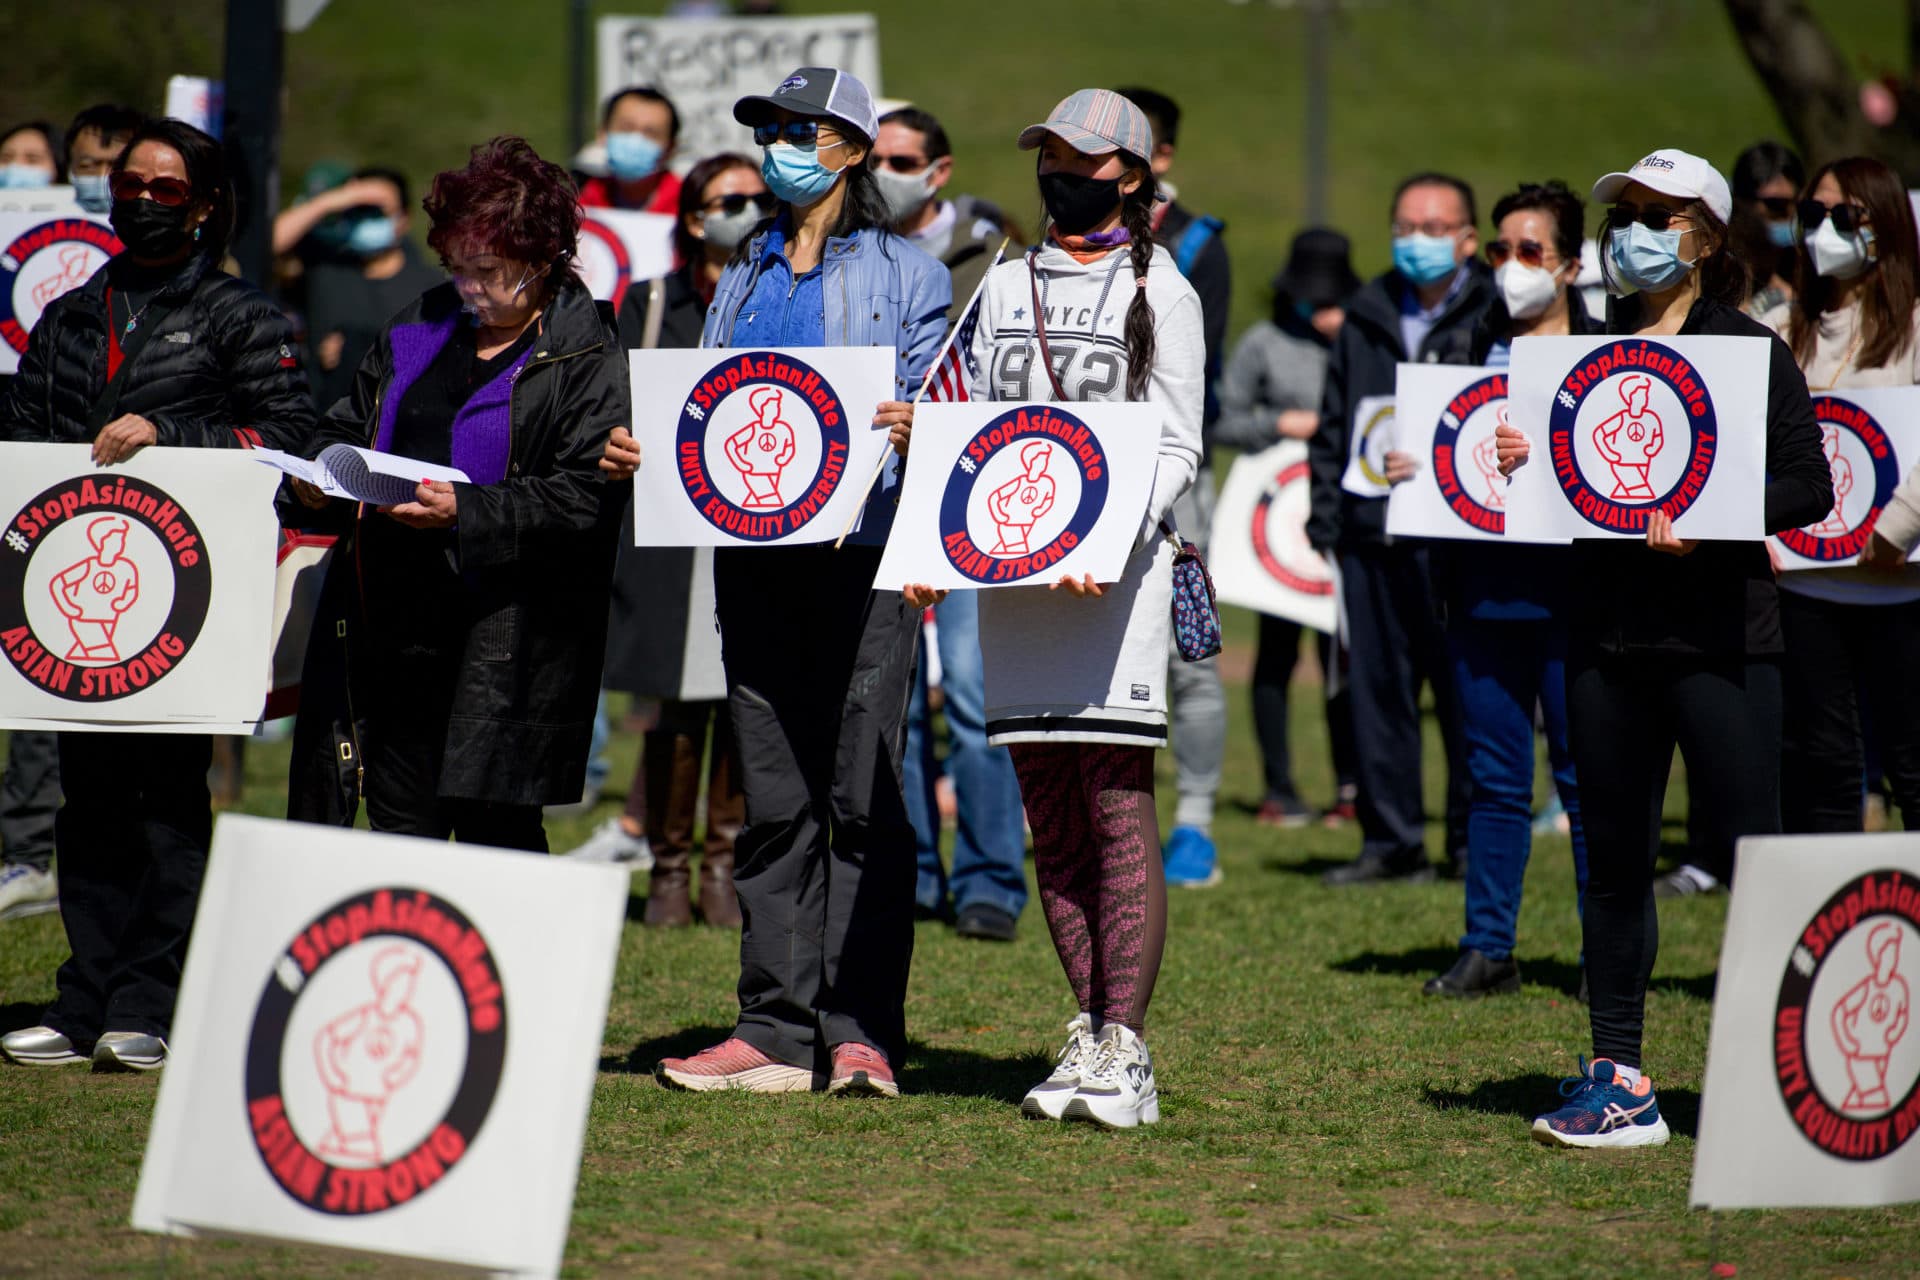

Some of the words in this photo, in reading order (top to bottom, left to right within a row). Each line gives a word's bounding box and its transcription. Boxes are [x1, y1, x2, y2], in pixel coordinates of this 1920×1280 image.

[1043, 306, 1091, 327] NYC
[685, 354, 839, 427] #StopAsianHate
[1557, 342, 1708, 417] #StopAsianHate
[958, 409, 1103, 481] #StopAsianHate
[1553, 431, 1581, 490] UNITY
[1661, 430, 1716, 522] DIVERSITY
[5, 477, 199, 568] #StopAsianHate
[680, 441, 712, 500] UNITY
[703, 497, 785, 537] EQUALITY
[788, 439, 847, 529] DIVERSITY
[944, 530, 996, 579] ASIAN
[992, 531, 1079, 581] STRONG
[1, 625, 75, 692] ASIAN
[79, 632, 186, 697] STRONG
[275, 888, 501, 1033] #StopAsianHate
[1775, 1006, 1809, 1098] UNITY
[1795, 1092, 1892, 1156] EQUALITY
[249, 1094, 327, 1201] ASIAN
[323, 1121, 467, 1212] STRONG
